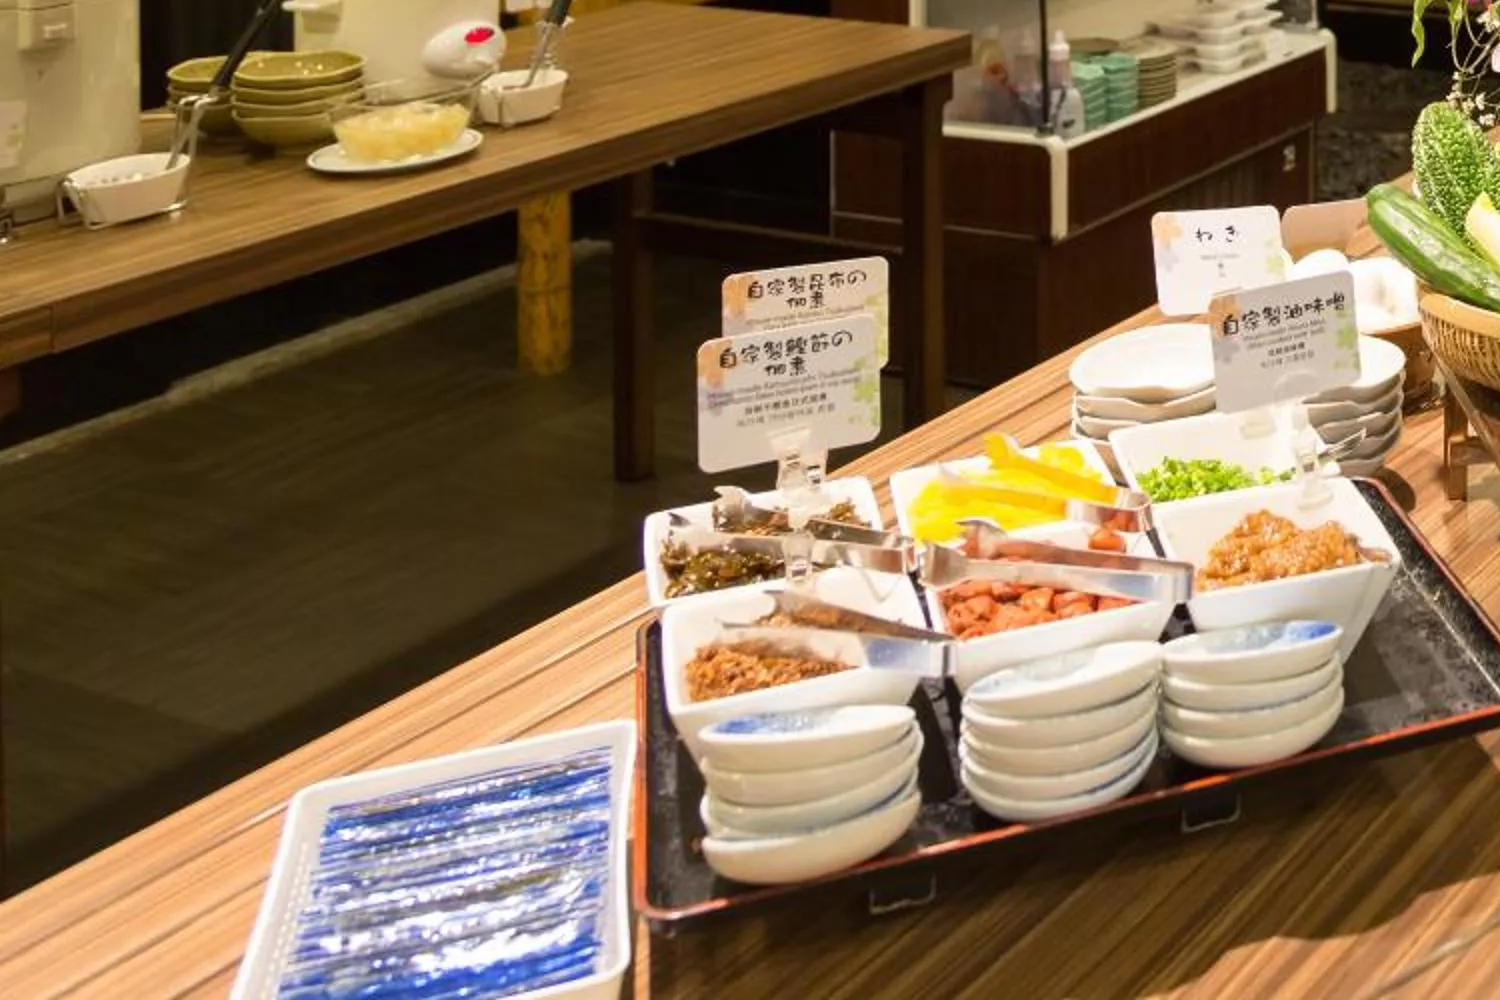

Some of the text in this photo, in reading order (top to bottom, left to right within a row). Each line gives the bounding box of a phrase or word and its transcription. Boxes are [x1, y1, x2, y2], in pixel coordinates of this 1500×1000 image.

[747, 269, 867, 299] 自家製昆布の
